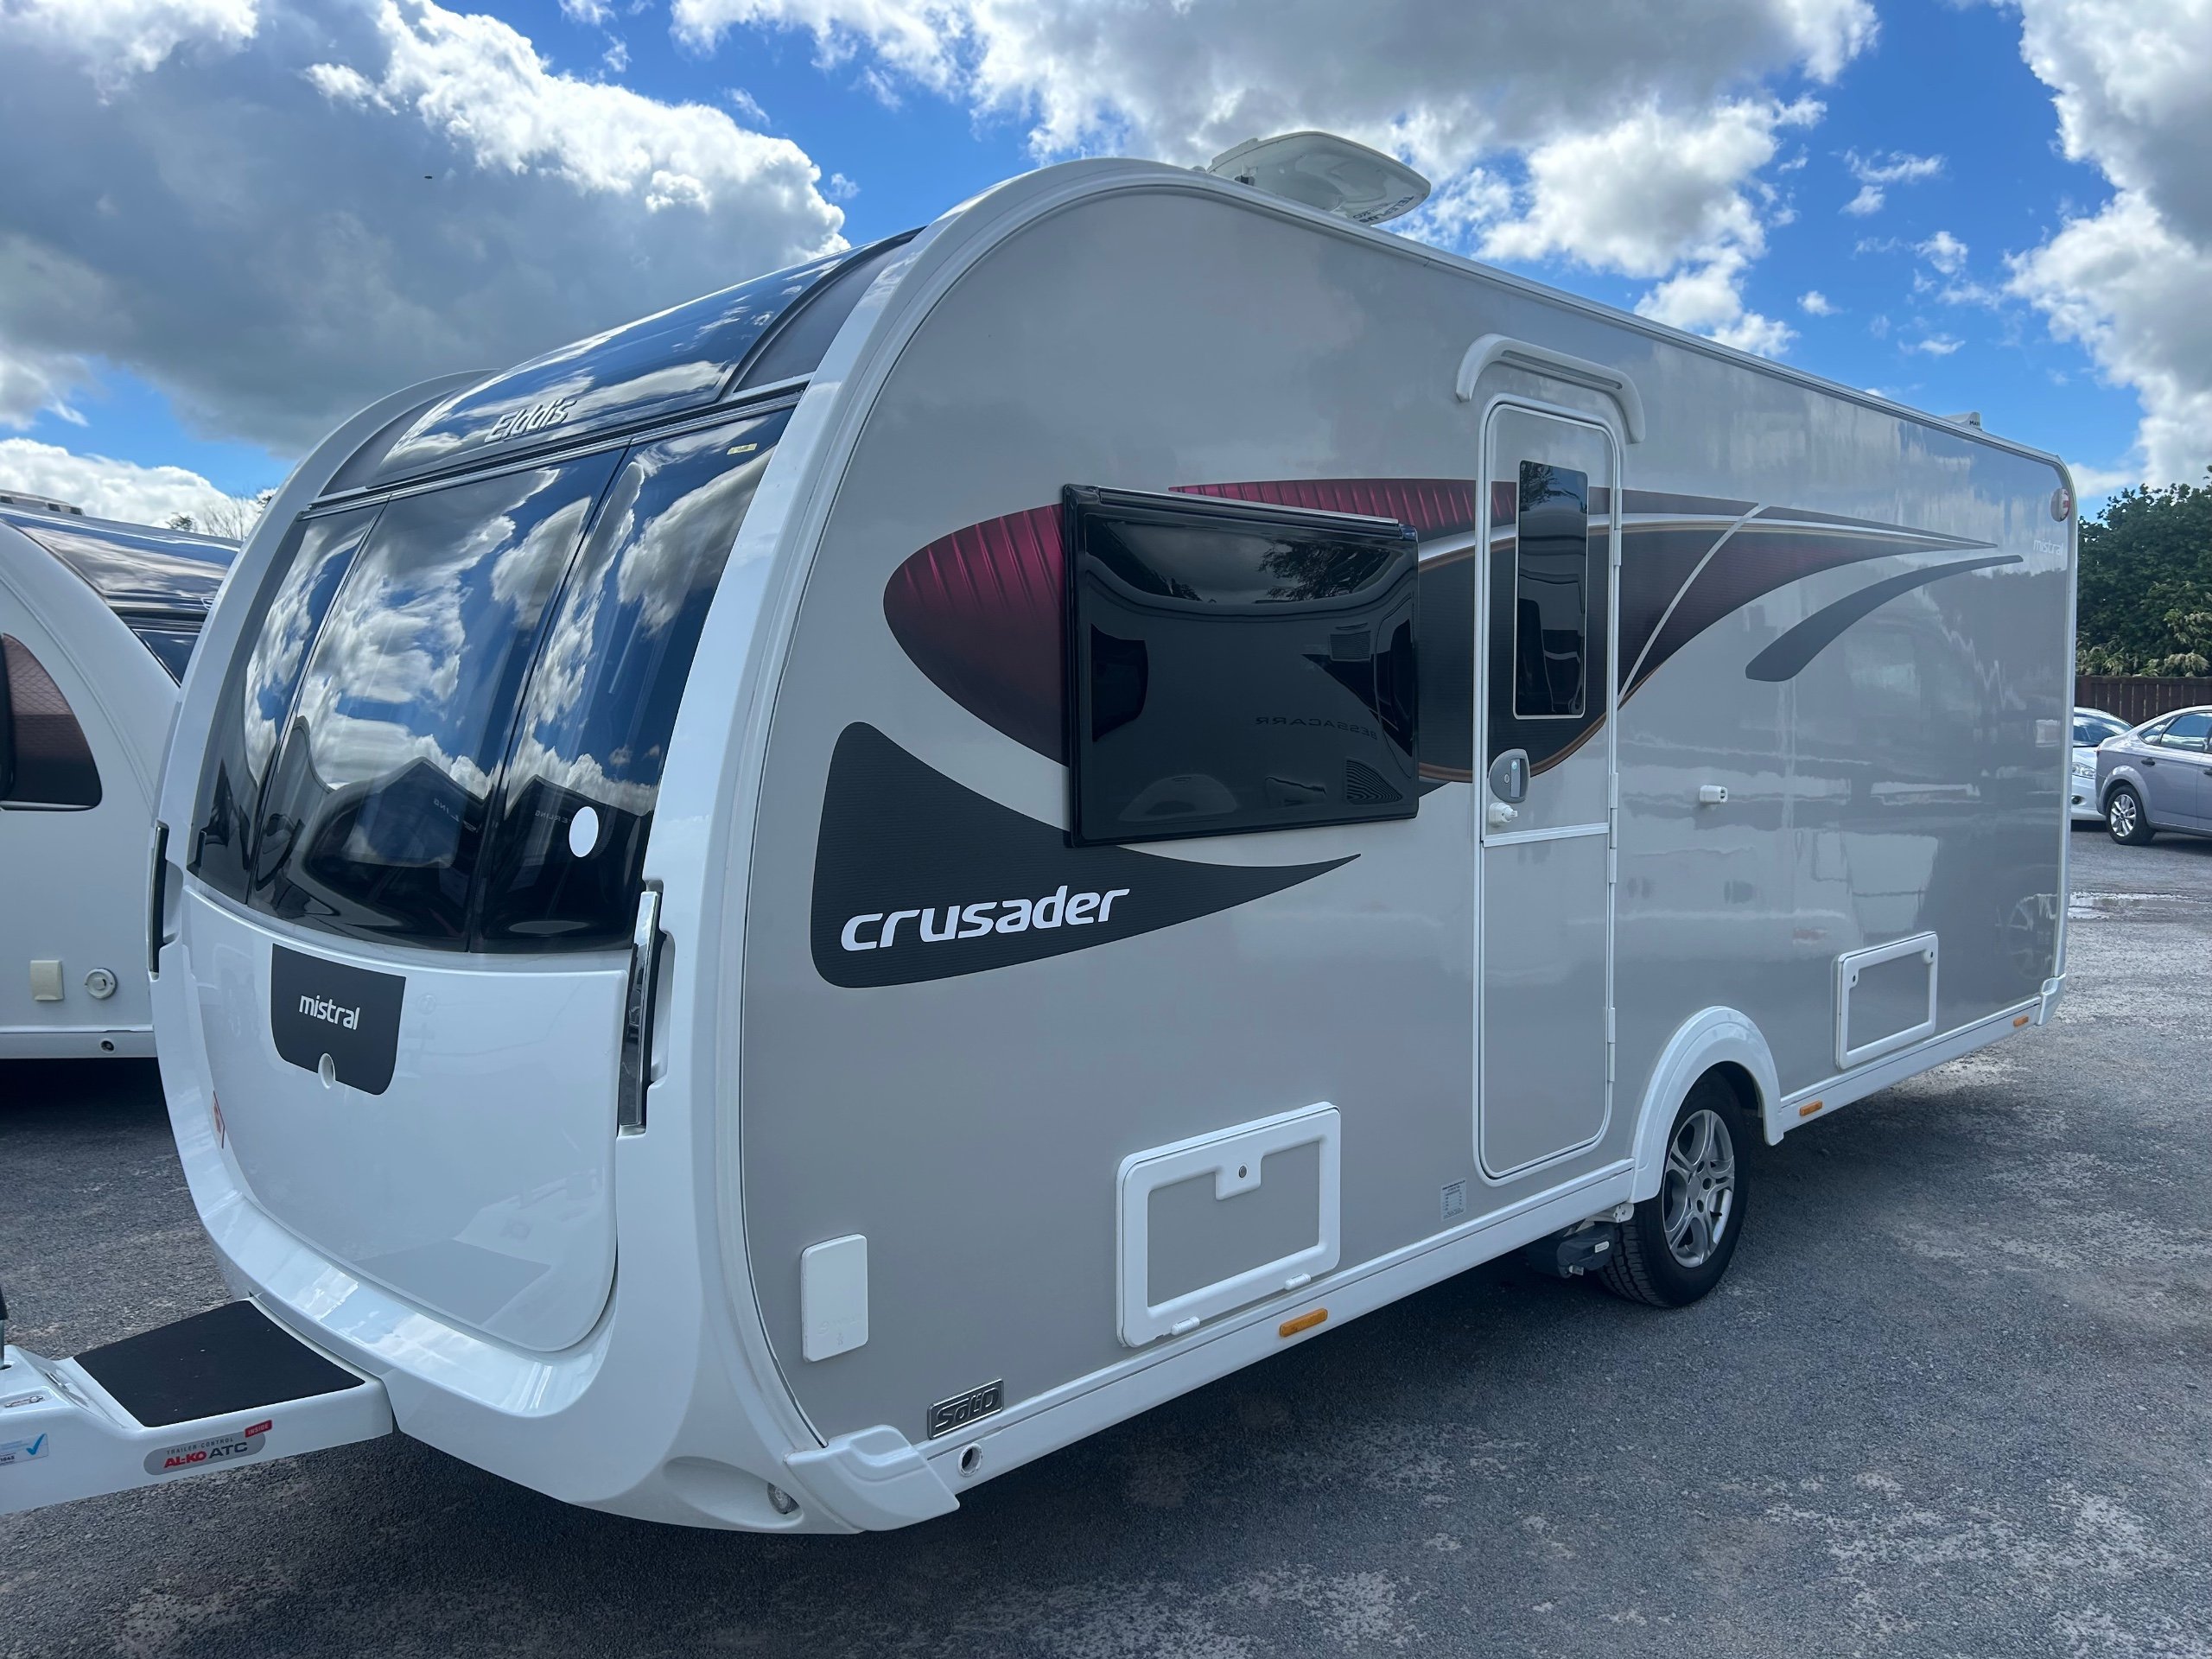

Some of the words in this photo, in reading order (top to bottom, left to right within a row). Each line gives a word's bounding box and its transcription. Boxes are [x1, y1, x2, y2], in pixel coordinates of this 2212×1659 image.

[484, 397, 578, 443] Elddis
[2032, 538, 2064, 556] mistral
[841, 885, 1130, 951] crusader
[298, 995, 360, 1030] mistral
[247, 1422, 270, 1436] INSIDE
[200, 1437, 234, 1449] CONTROL
[208, 1441, 248, 1459] ATC
